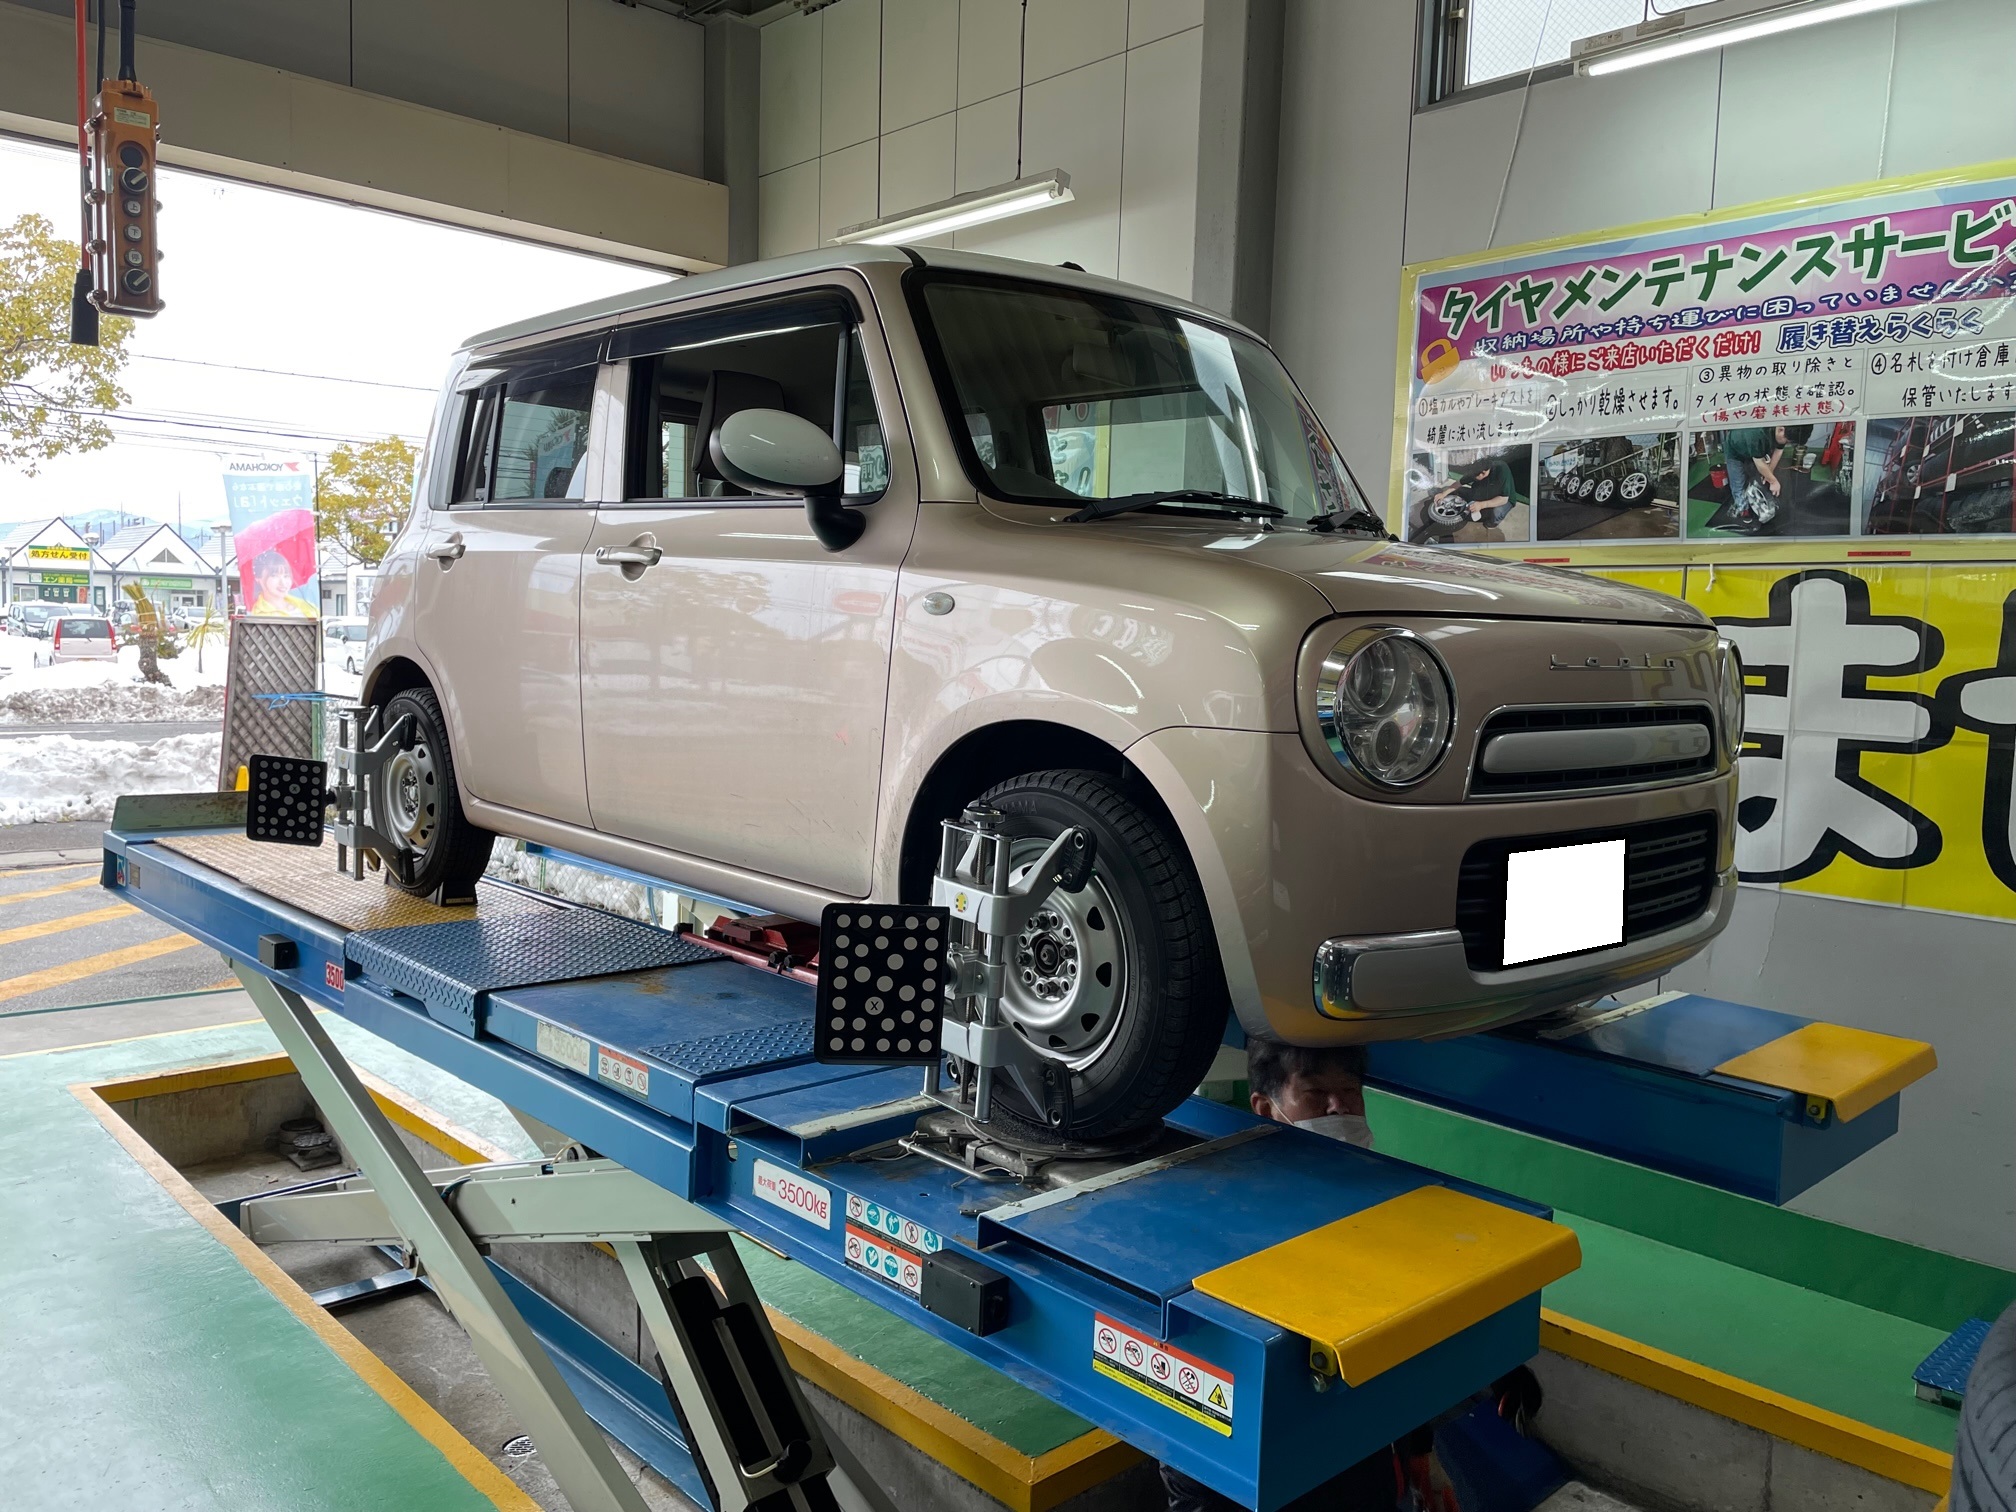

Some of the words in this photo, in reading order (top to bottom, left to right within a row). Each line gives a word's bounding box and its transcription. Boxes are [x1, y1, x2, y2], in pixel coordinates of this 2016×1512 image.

[1442, 204, 2016, 336] タイヤメンテナンスサービ
[1777, 307, 1984, 353] 履き替えらくらく
[1699, 356, 1853, 383] ③異物の取り除きと
[1871, 343, 2016, 374] ④名札を付け倉庫
[1696, 381, 1855, 408] タイヤの状態を確認。
[31, 550, 88, 560] 処方せん受付
[778, 1179, 827, 1219] 3500kg
